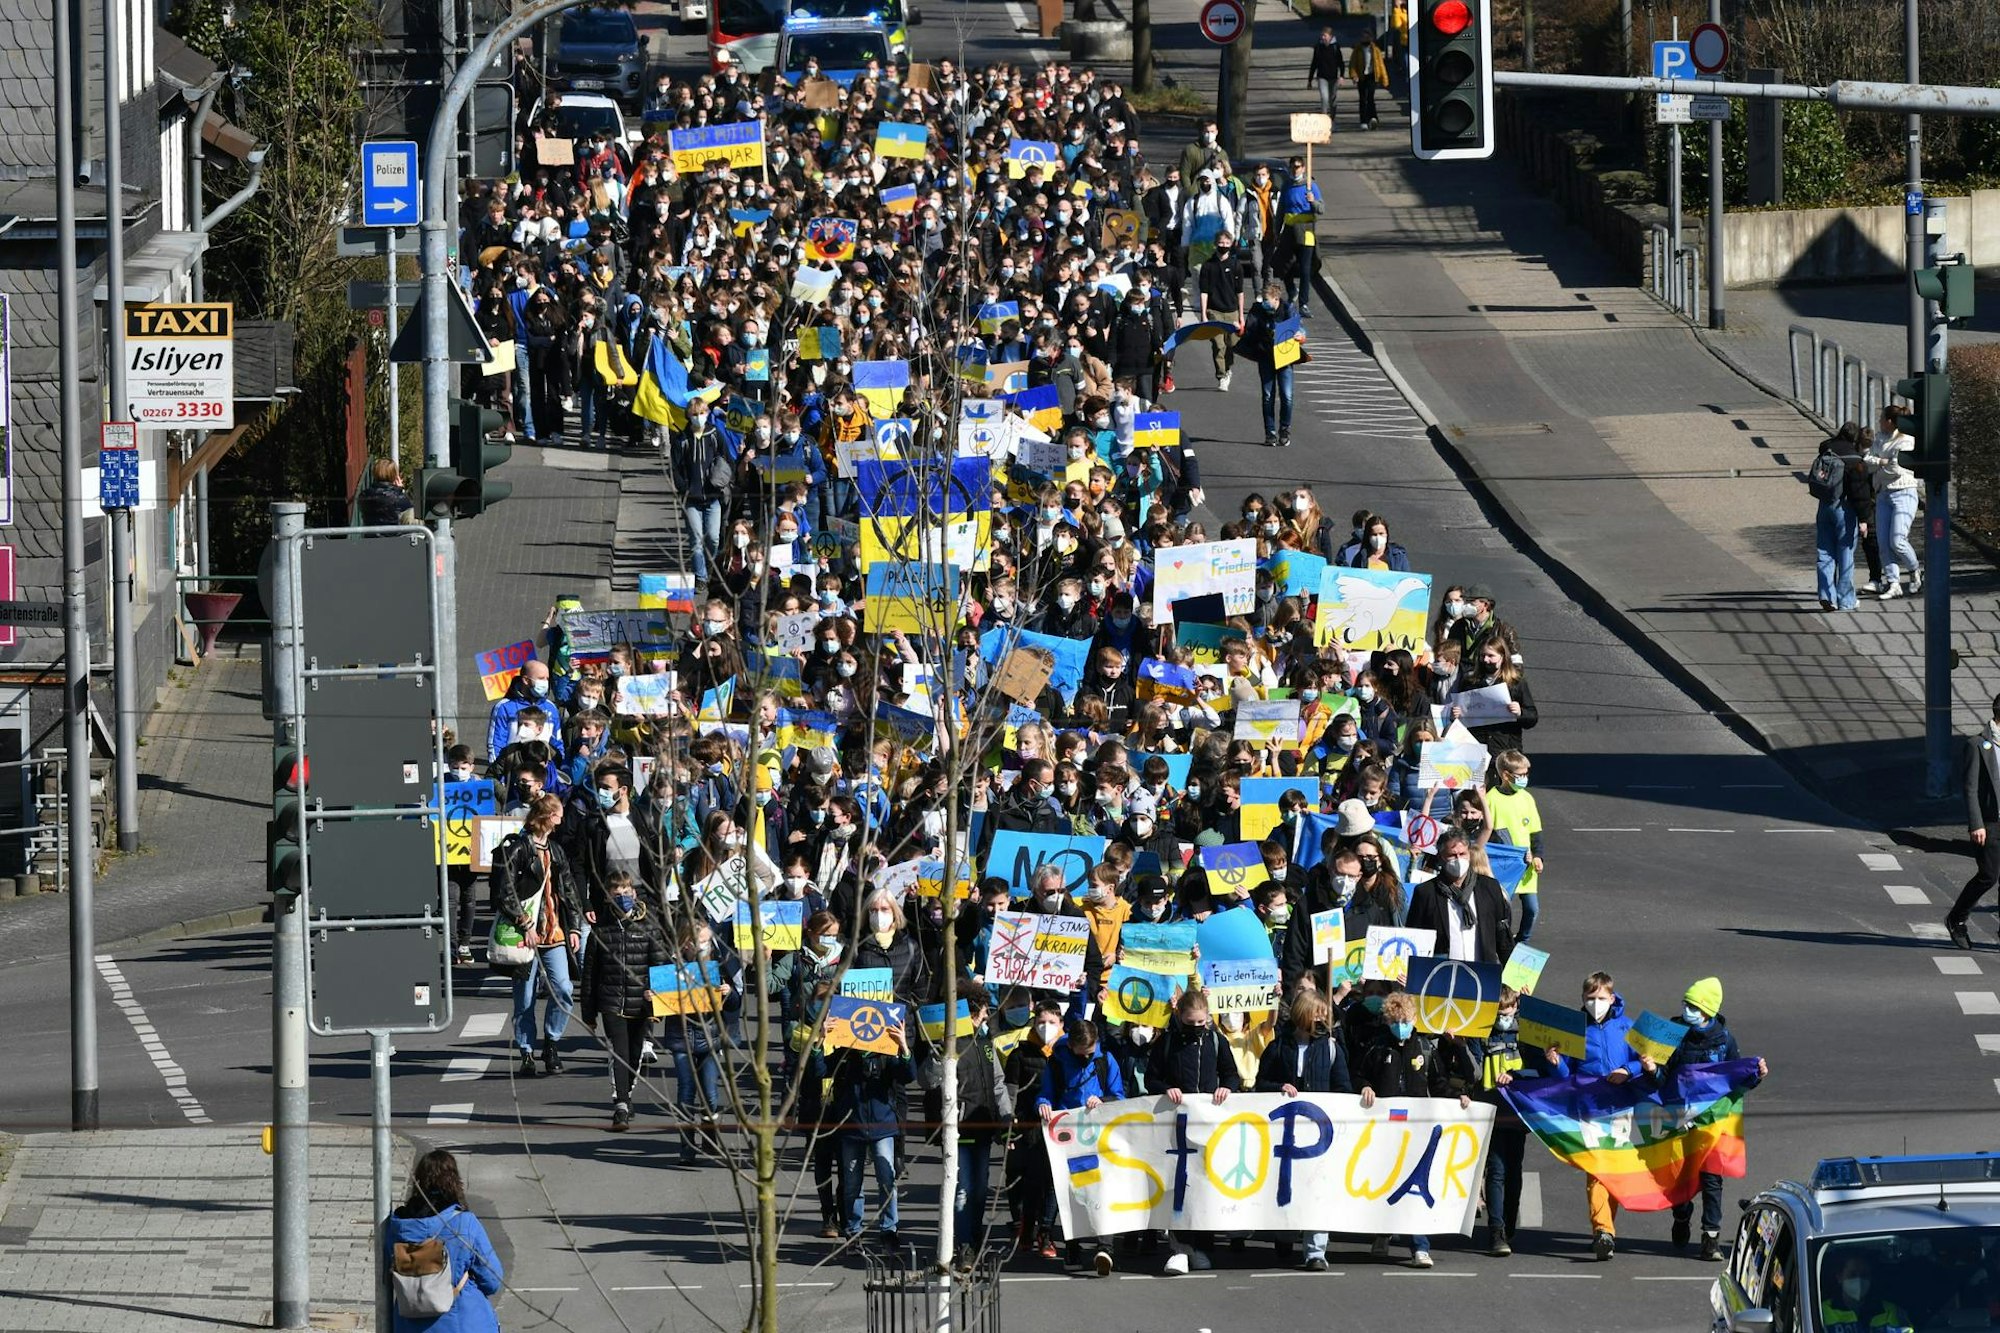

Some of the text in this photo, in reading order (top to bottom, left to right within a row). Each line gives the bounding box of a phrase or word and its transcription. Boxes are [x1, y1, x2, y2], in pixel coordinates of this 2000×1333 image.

[1663, 47, 1686, 78] P
[678, 150, 715, 169] STOP
[376, 164, 405, 175] Polizei
[133, 310, 219, 333] TAXI
[131, 346, 223, 376] Isliyen
[147, 389, 205, 397] Vertrauenssache
[142, 402, 223, 418] 02267 3330
[483, 641, 533, 673] STOP
[484, 669, 520, 693] PUT
[438, 840, 472, 857] WA
[1013, 846, 1093, 893] NO
[1042, 915, 1058, 924] WE
[1034, 938, 1087, 956] UKRAINE
[993, 956, 1030, 971] STOP
[1043, 974, 1071, 986] STOP
[1214, 970, 1232, 983] Für
[1234, 969, 1250, 981] den
[843, 980, 893, 1002] FRIEDEN
[1218, 992, 1274, 1009] UKRAINE
[1345, 1118, 1480, 1209] WAR
